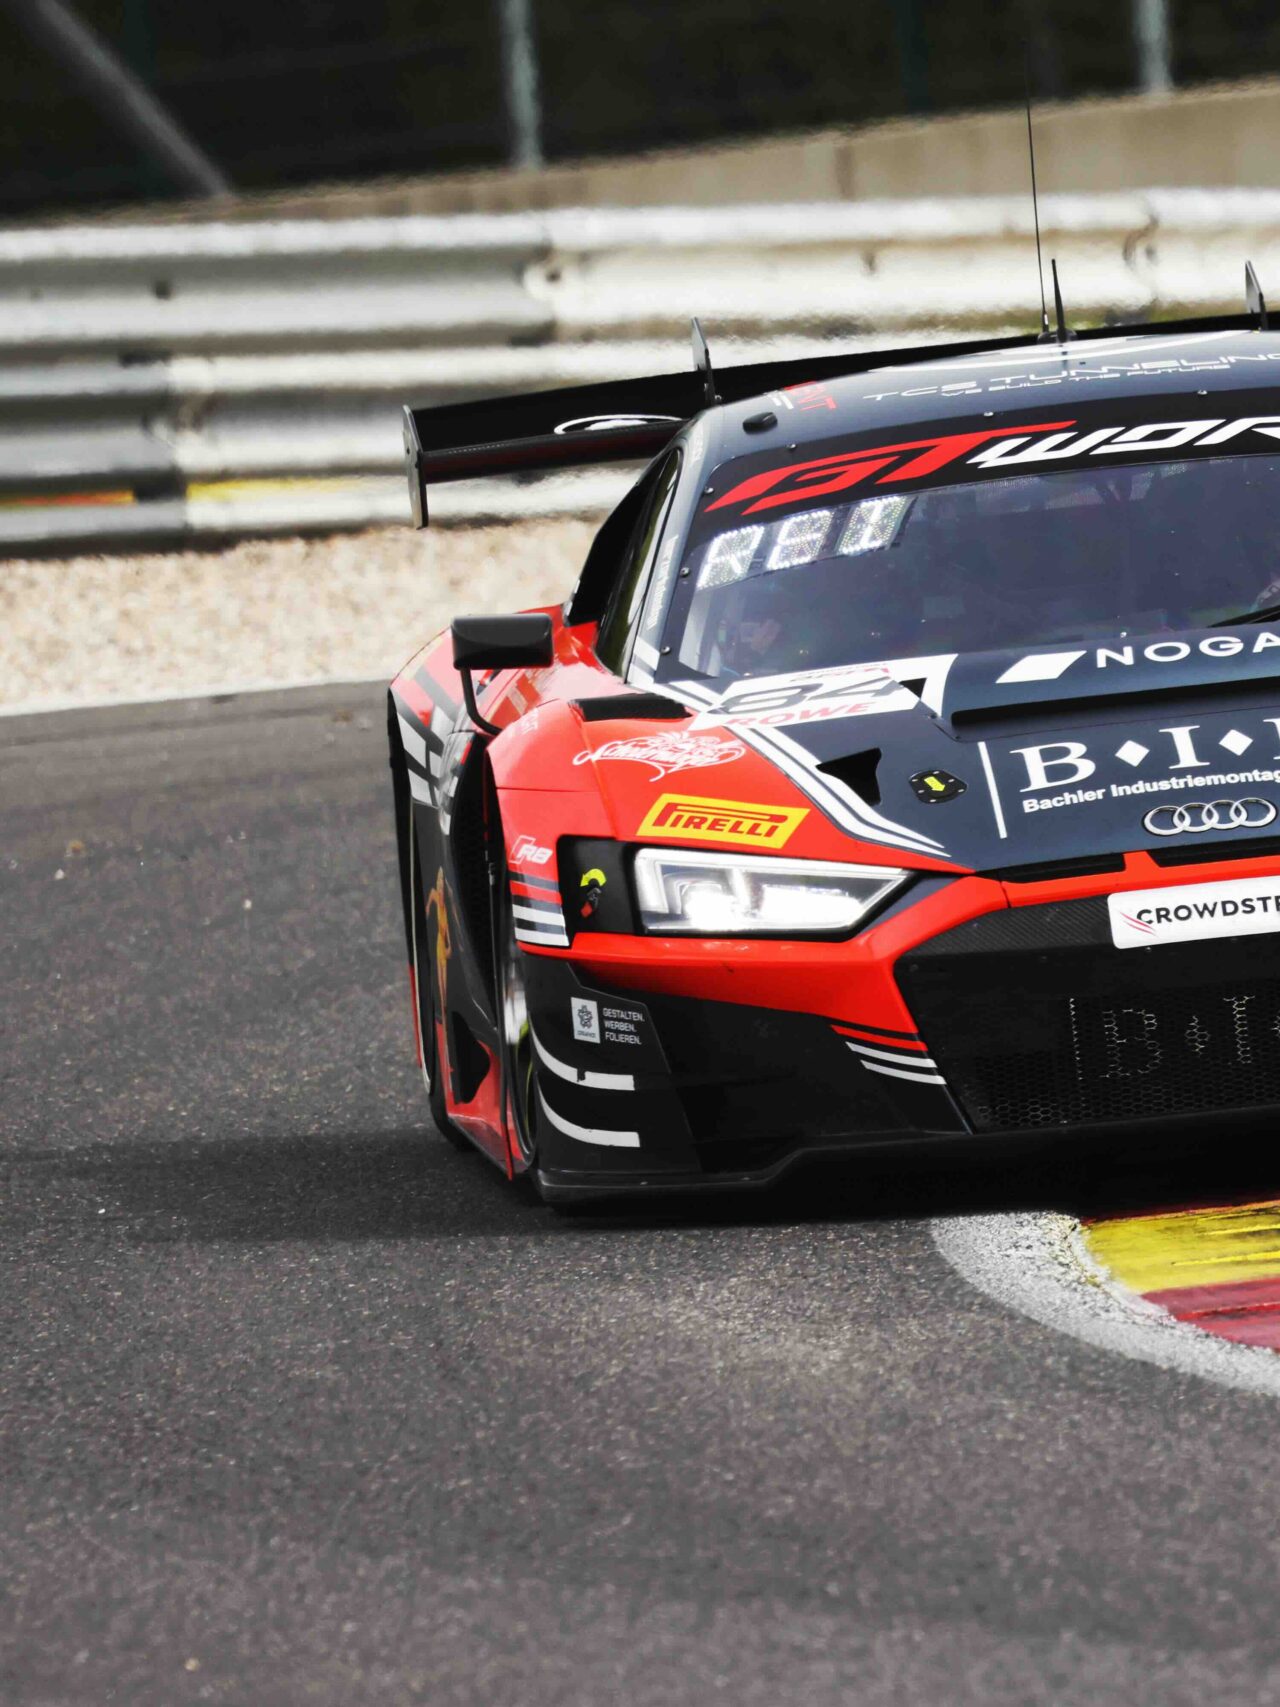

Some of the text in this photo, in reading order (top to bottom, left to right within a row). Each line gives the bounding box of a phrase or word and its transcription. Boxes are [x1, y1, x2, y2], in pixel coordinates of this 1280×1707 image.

[988, 379, 1062, 391] BUILD
[1069, 373, 1120, 382] THE
[1127, 364, 1231, 376] FUTURE
[862, 381, 977, 401] TCS
[724, 701, 876, 725] ROWE
[1022, 786, 1106, 813] Bachler
[652, 802, 788, 838] PIRELLI
[513, 840, 553, 865] R8
